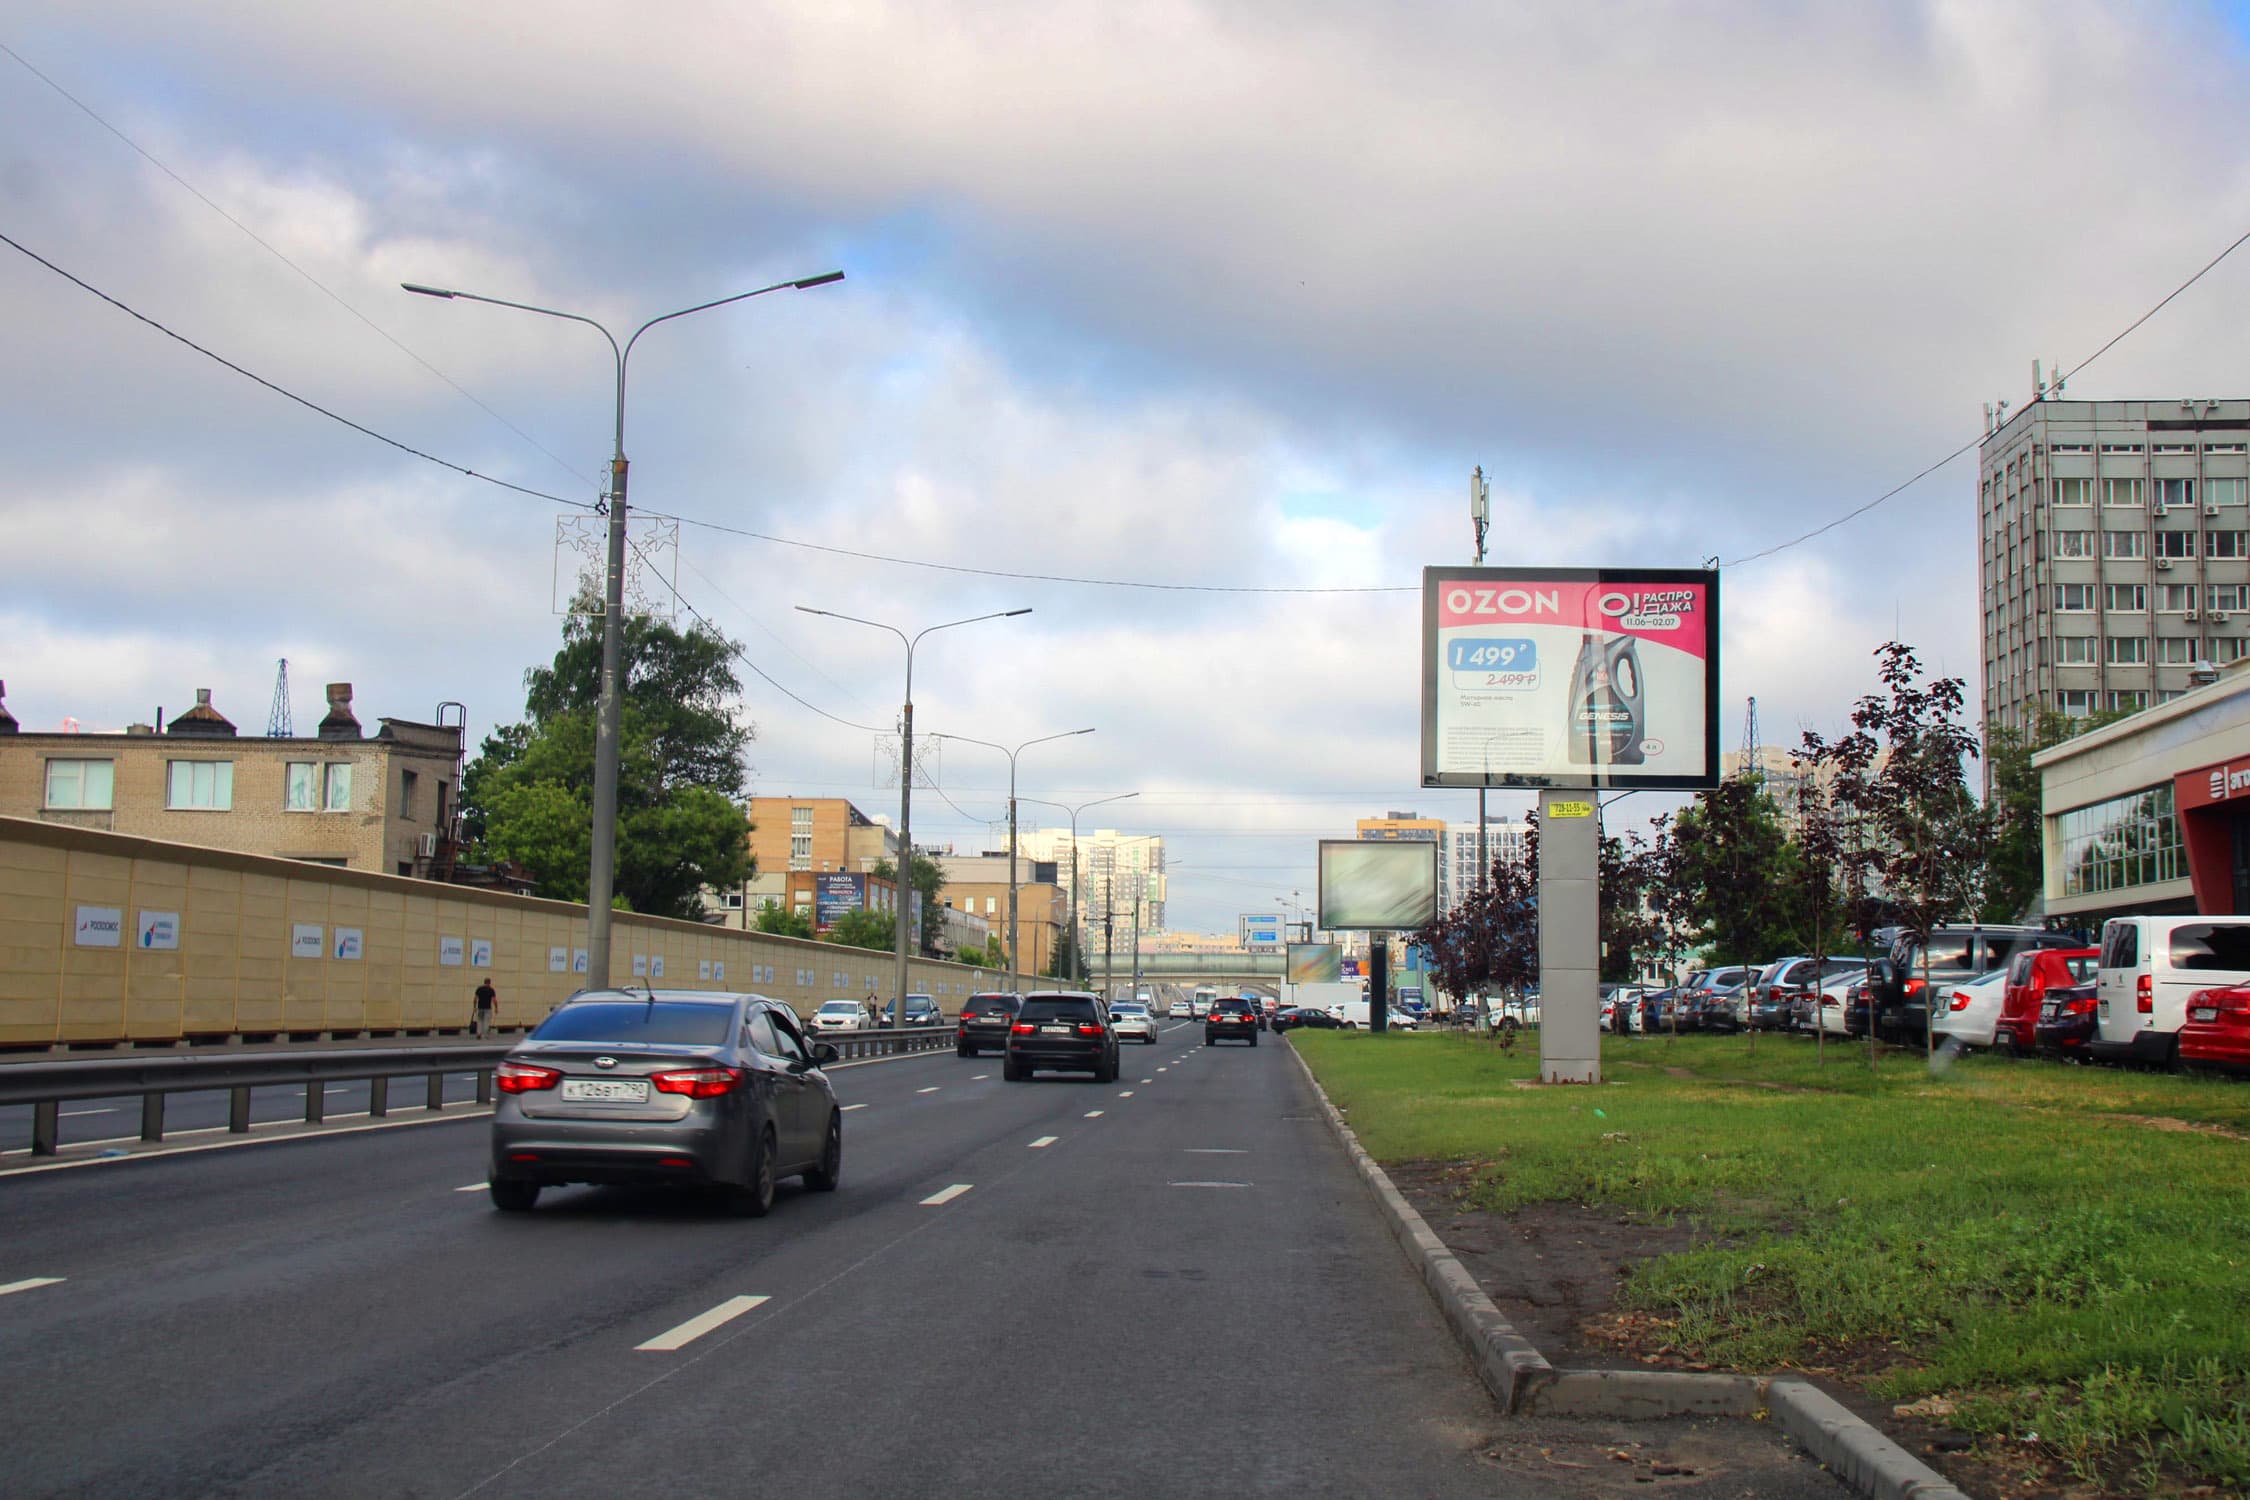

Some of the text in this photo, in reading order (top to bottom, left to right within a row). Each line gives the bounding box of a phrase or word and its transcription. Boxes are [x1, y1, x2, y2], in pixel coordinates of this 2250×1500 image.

[1447, 589, 1559, 615] OZON
[1643, 590, 1693, 603] РАСПРО
[1641, 602, 1693, 616] ДАЖА
[1578, 711, 1630, 721] GENESIS
